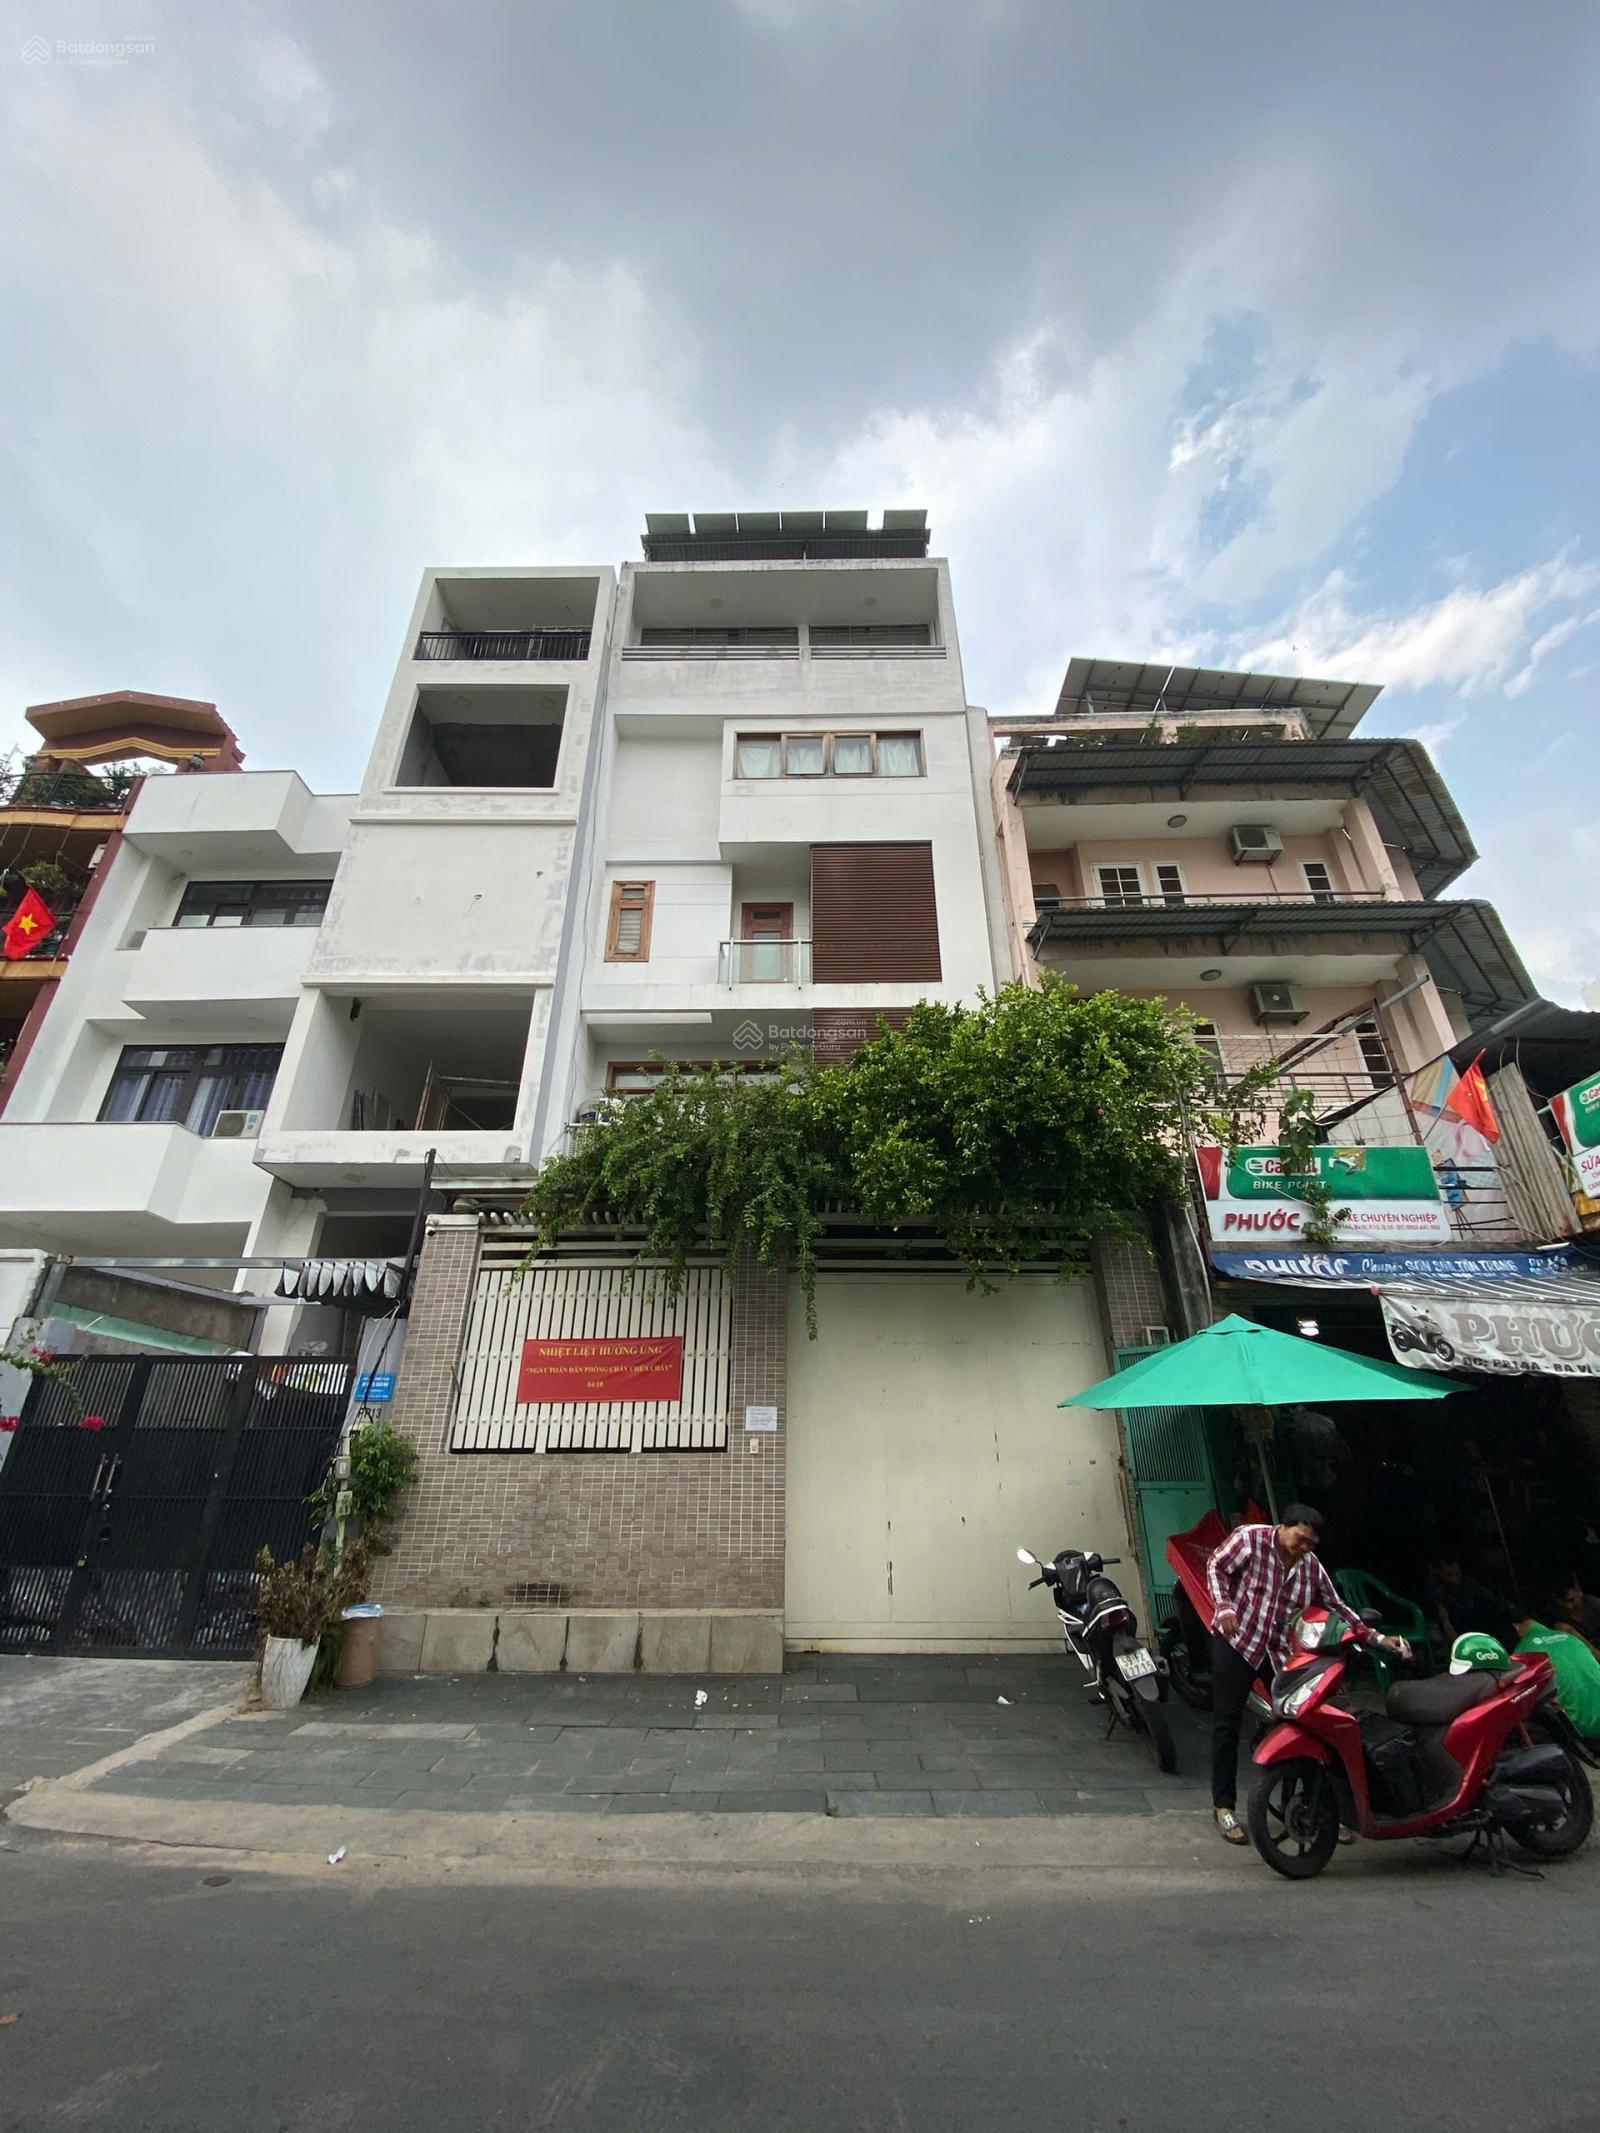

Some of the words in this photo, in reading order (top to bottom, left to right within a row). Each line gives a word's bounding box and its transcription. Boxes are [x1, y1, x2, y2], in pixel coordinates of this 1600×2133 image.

[1253, 1181, 1282, 1189] BIKE
[1224, 1208, 1300, 1231] PHƯỚC
[1360, 1212, 1399, 1222] CHUYÊN
[1401, 1211, 1437, 1224] NGHIỆP
[539, 1346, 570, 1357] NHIỆT
[573, 1346, 597, 1357] LIỆT
[599, 1343, 638, 1355] HƯỞNG
[1476, 1649, 1499, 1660] Grab
